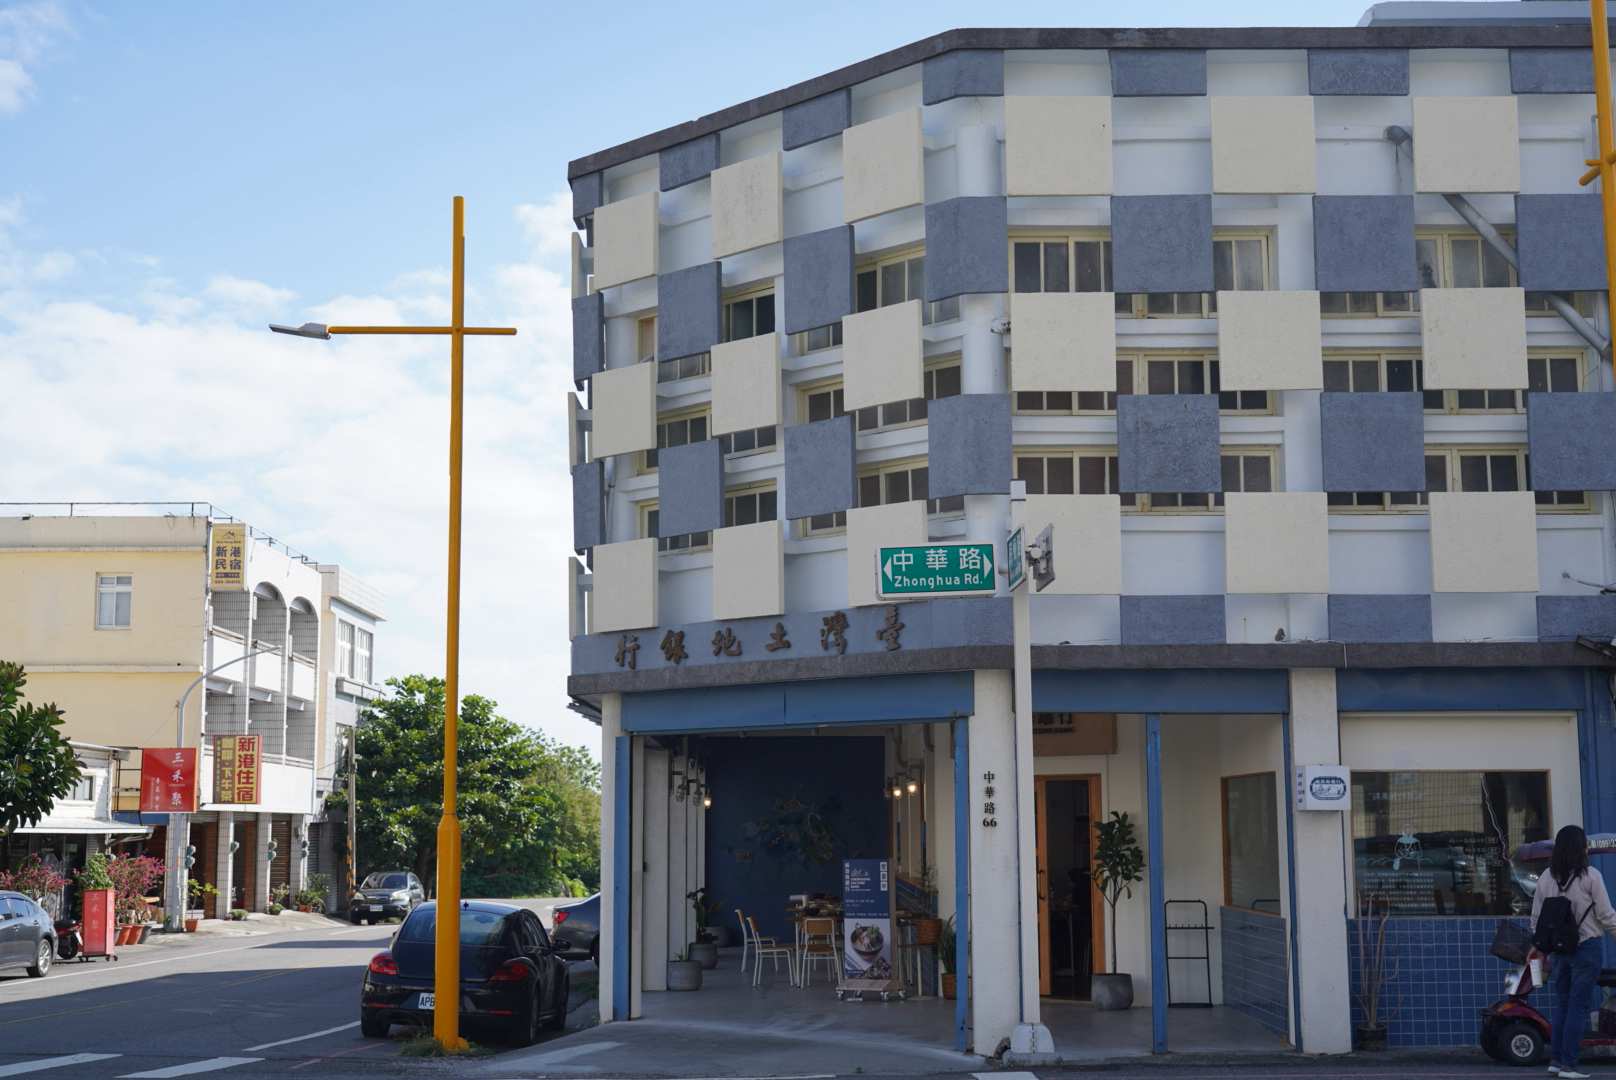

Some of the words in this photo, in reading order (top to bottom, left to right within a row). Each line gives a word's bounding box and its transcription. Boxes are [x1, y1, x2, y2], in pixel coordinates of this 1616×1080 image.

[216, 546, 241, 557] 新港
[215, 558, 242, 570] 民宿
[893, 548, 982, 572] 中華路
[894, 574, 961, 589] Zhonghua
[964, 573, 983, 586] Rd.
[236, 736, 256, 802] 新港住宿
